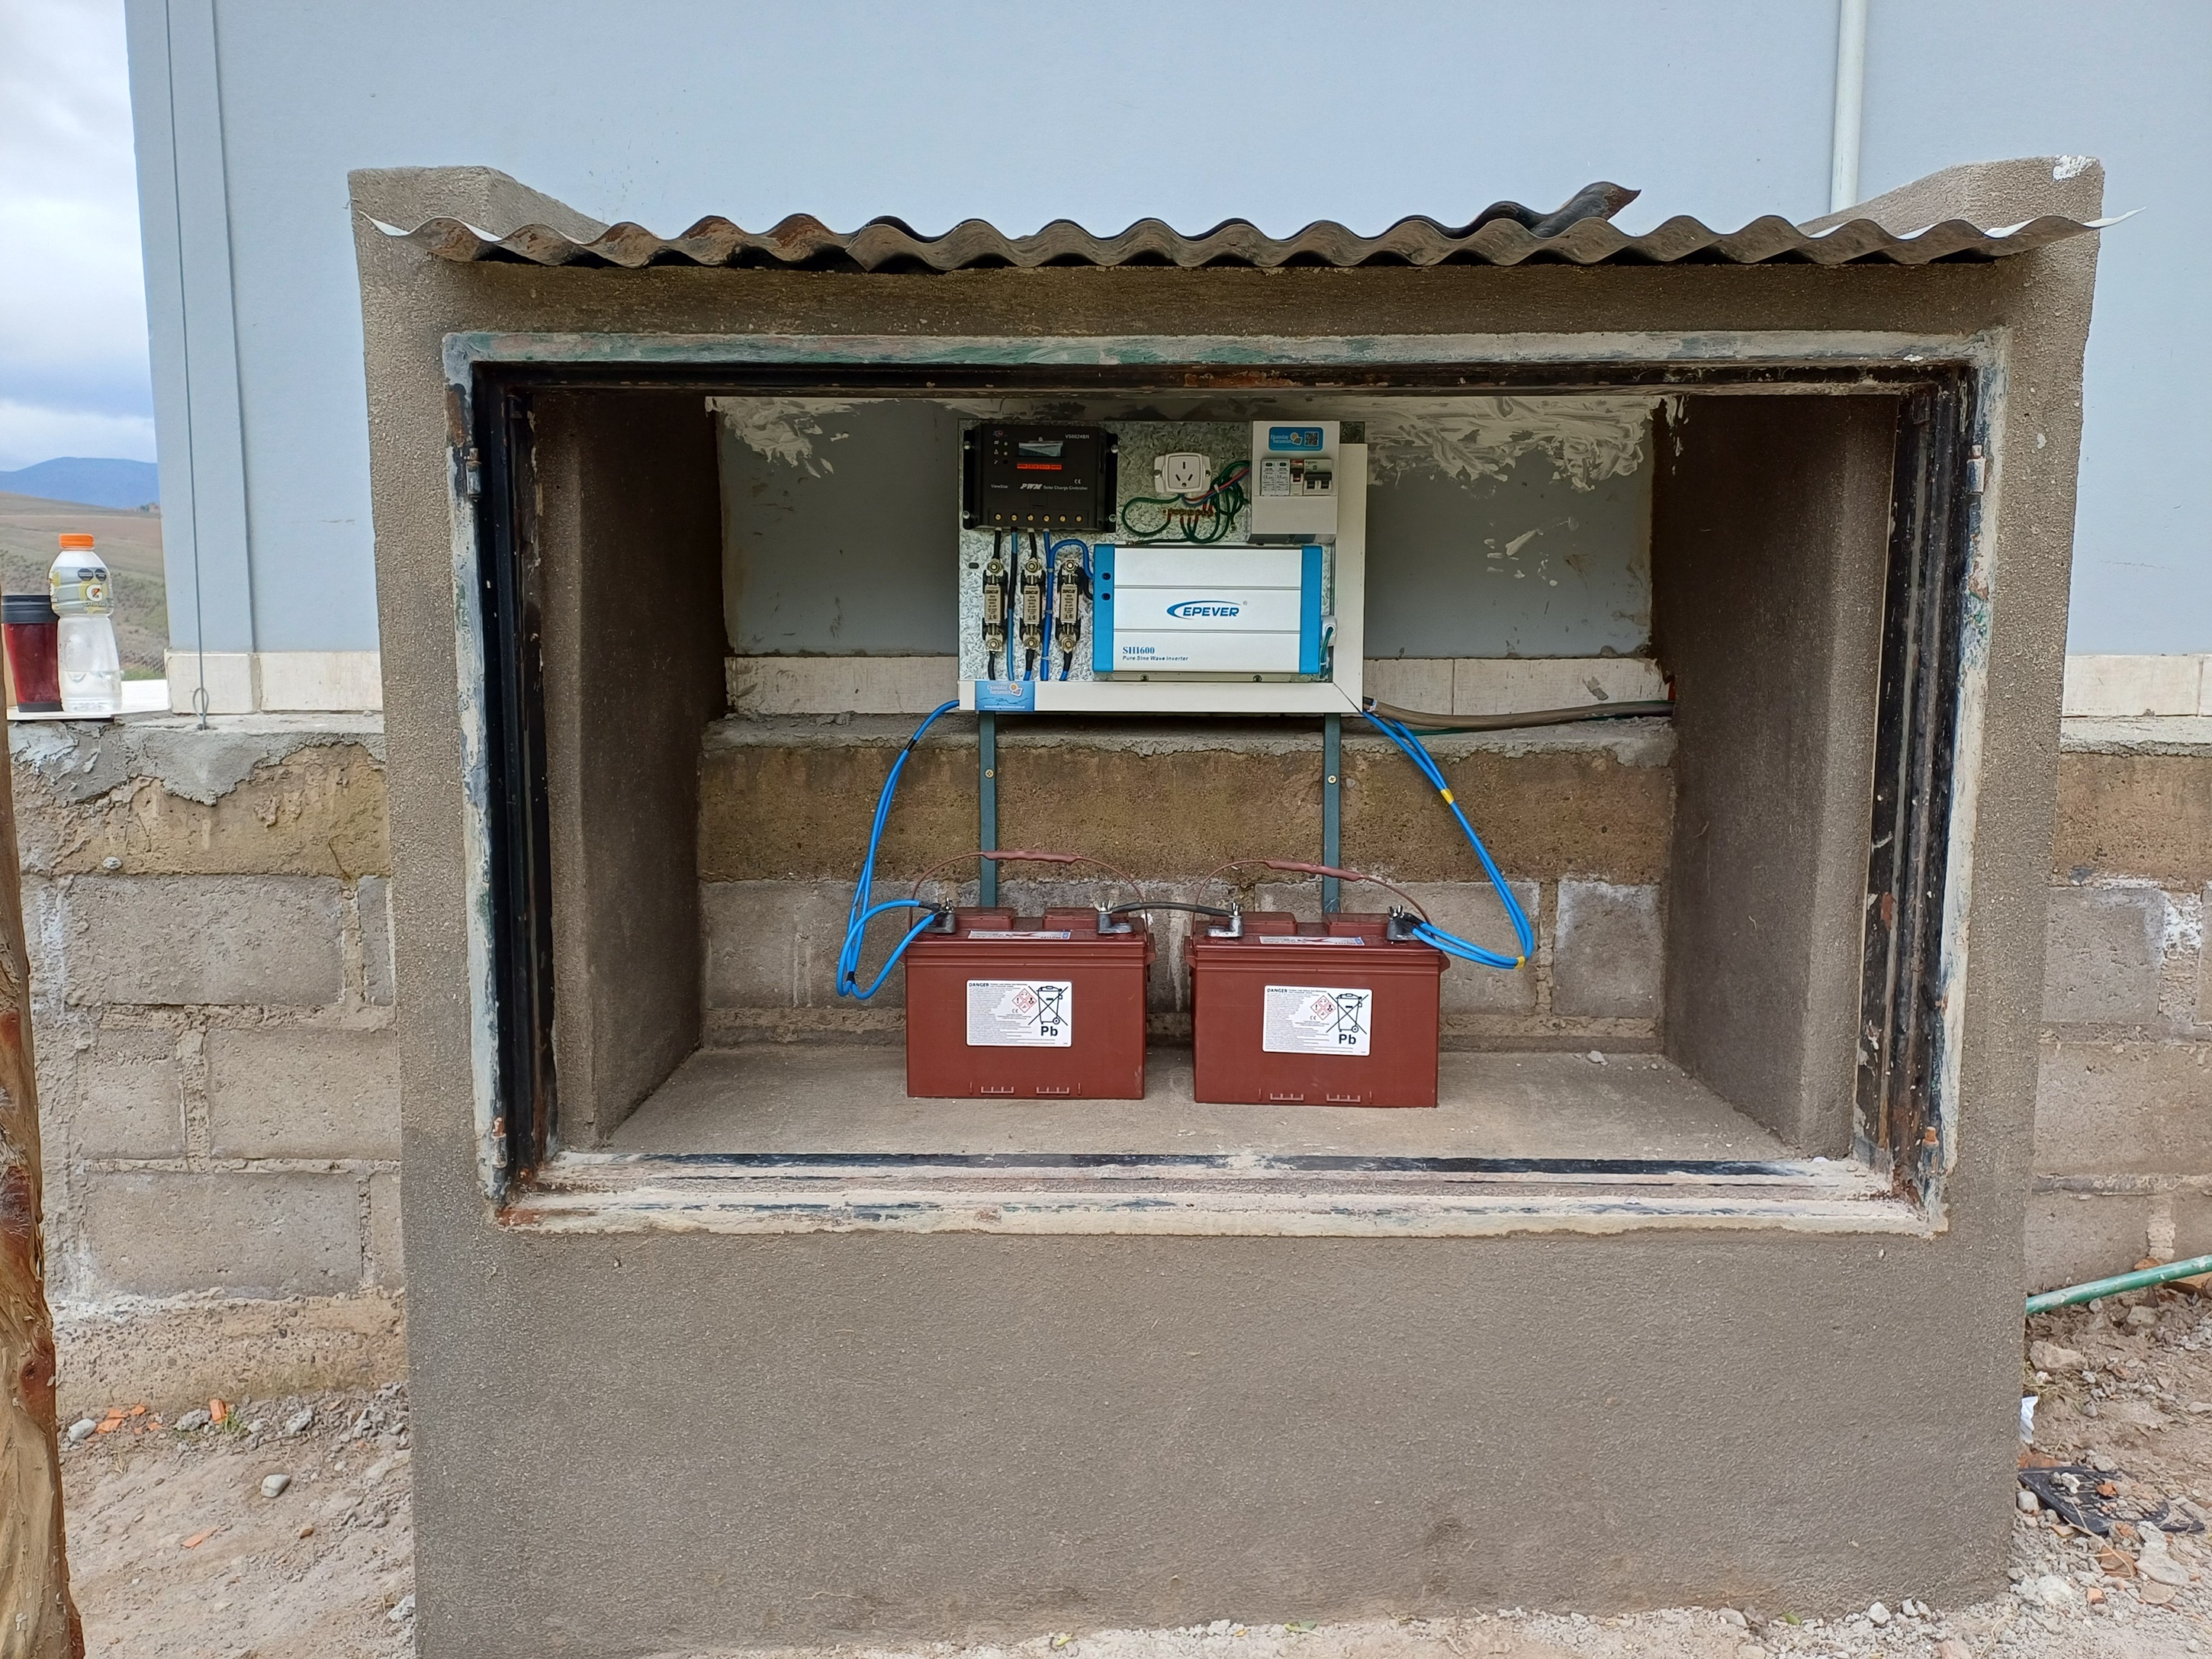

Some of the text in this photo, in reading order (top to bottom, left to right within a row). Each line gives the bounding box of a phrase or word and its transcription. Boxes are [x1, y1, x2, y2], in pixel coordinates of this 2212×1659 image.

[1182, 606, 1239, 617] EPEVER
[1040, 1026, 1058, 1037] Pb
[1339, 1034, 1356, 1045] Pb
